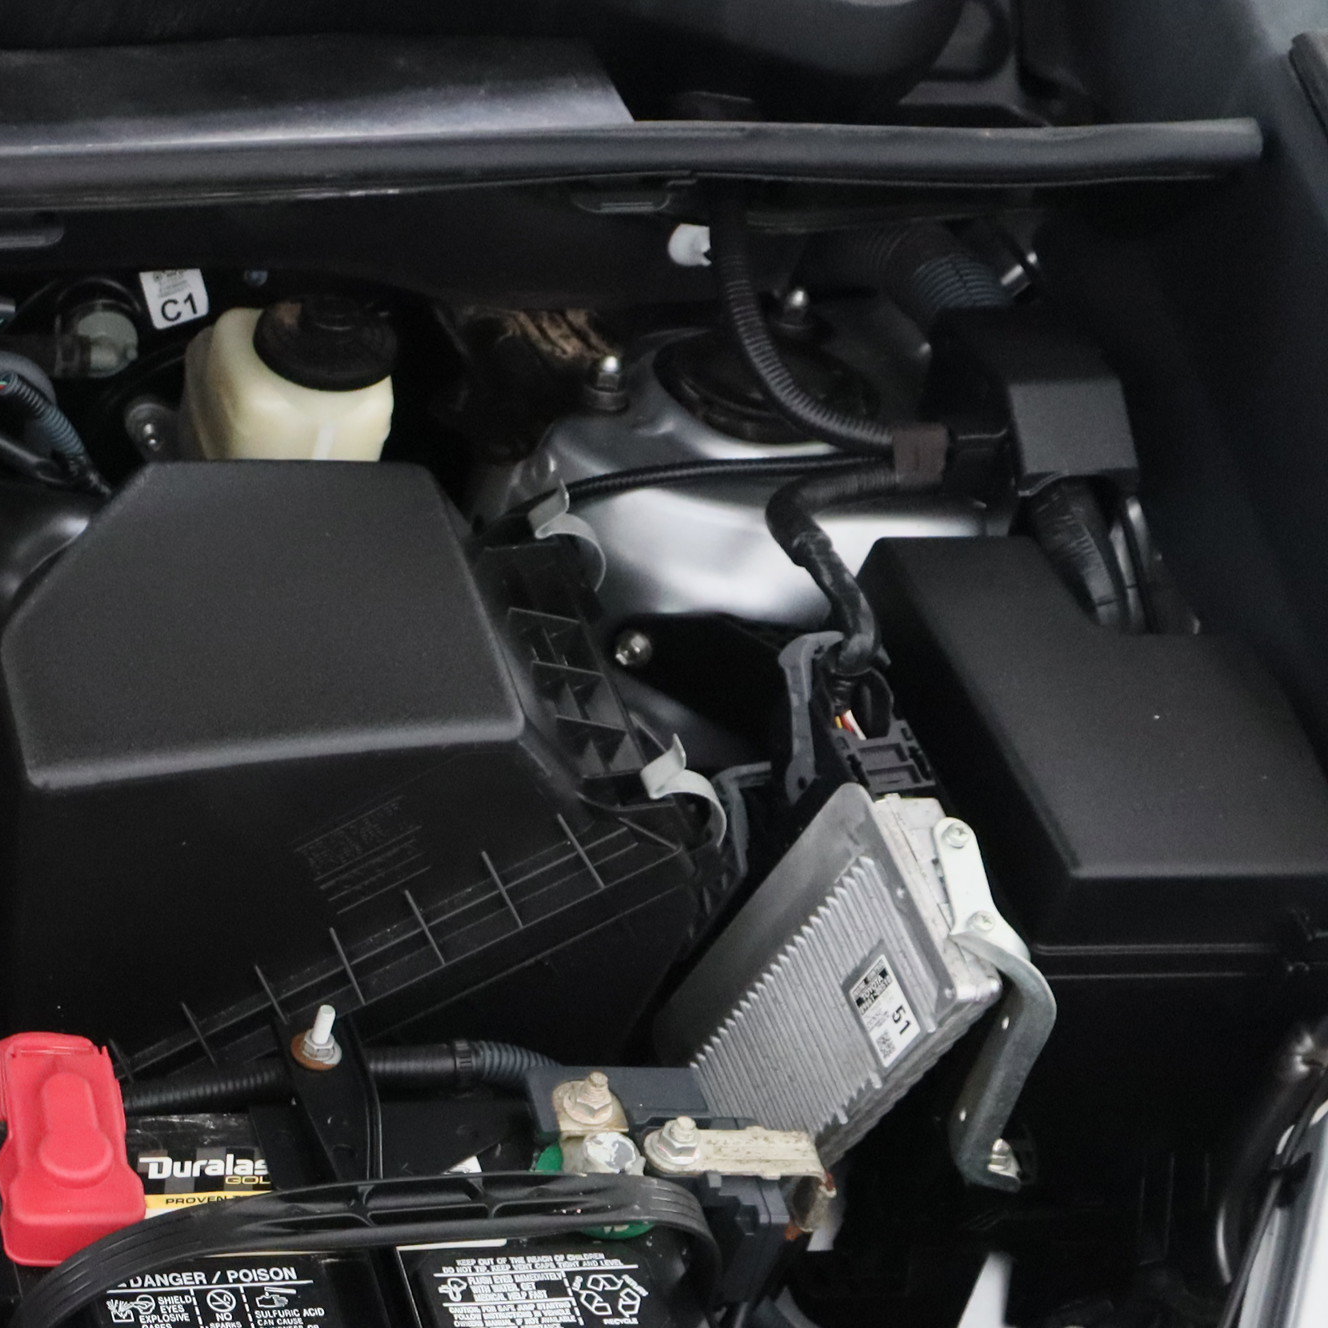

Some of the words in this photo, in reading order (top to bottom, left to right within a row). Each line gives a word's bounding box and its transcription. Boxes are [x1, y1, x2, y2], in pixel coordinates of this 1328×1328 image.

[161, 292, 197, 322] C1
[892, 1004, 911, 1035] 51
[139, 1154, 270, 1179] Duralas
[225, 1176, 271, 1185] GOL
[129, 1272, 207, 1288] DANGER
[226, 1266, 297, 1283] POISON
[157, 1295, 192, 1305] SHIELD
[160, 1304, 185, 1314] EYES
[255, 1309, 300, 1319] SULFURIC
[303, 1307, 325, 1317] ACID
[139, 1313, 190, 1324] EXPLOSIVE
[215, 1312, 233, 1322] NO
[277, 1317, 304, 1325] CAUSE
